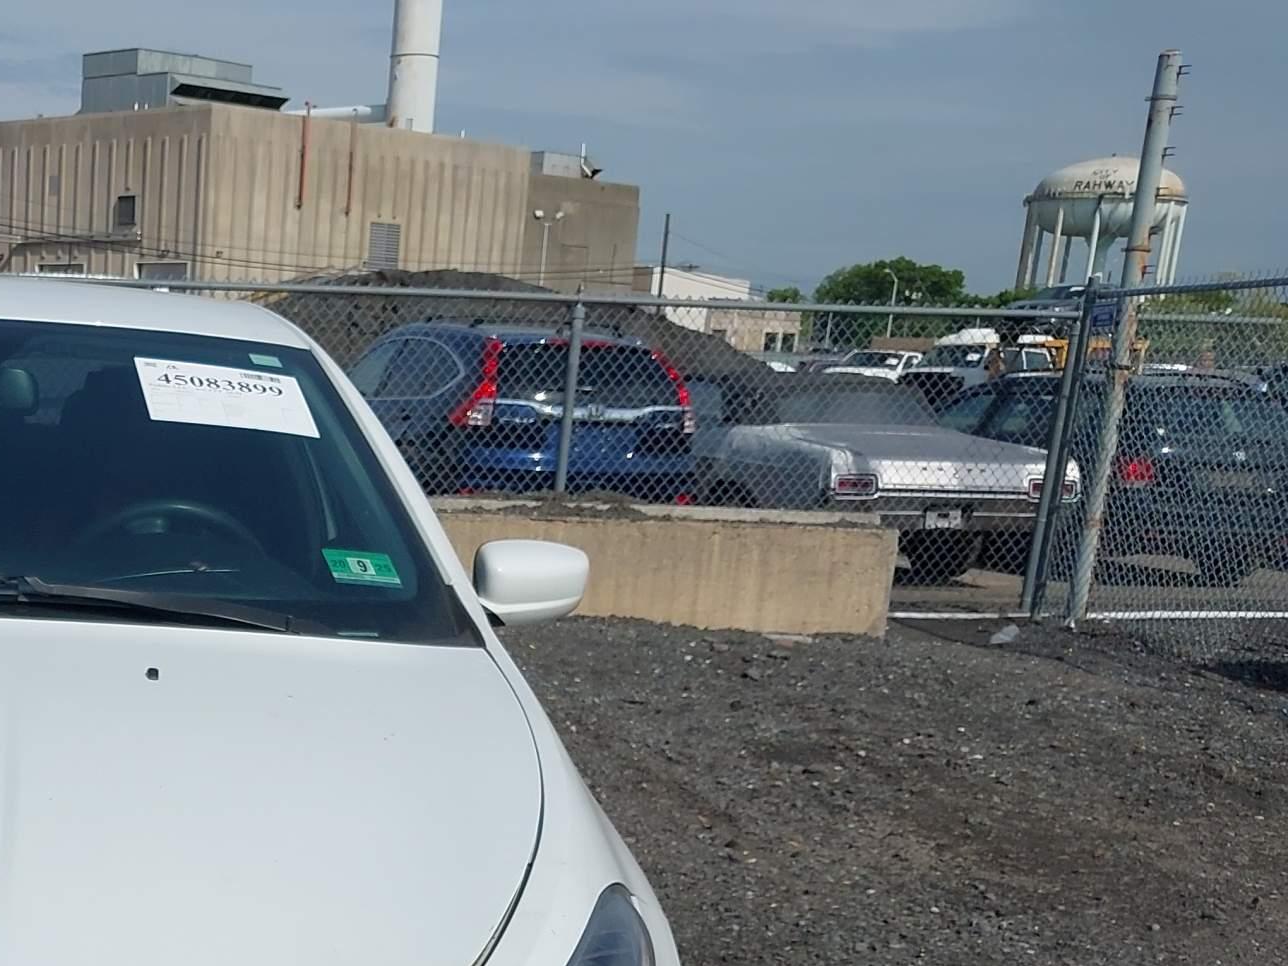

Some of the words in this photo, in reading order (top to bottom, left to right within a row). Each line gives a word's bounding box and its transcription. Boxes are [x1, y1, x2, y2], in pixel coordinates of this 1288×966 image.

[1073, 180, 1135, 190] RAHWAY
[157, 372, 283, 397] 45083899
[356, 559, 368, 573] 9
